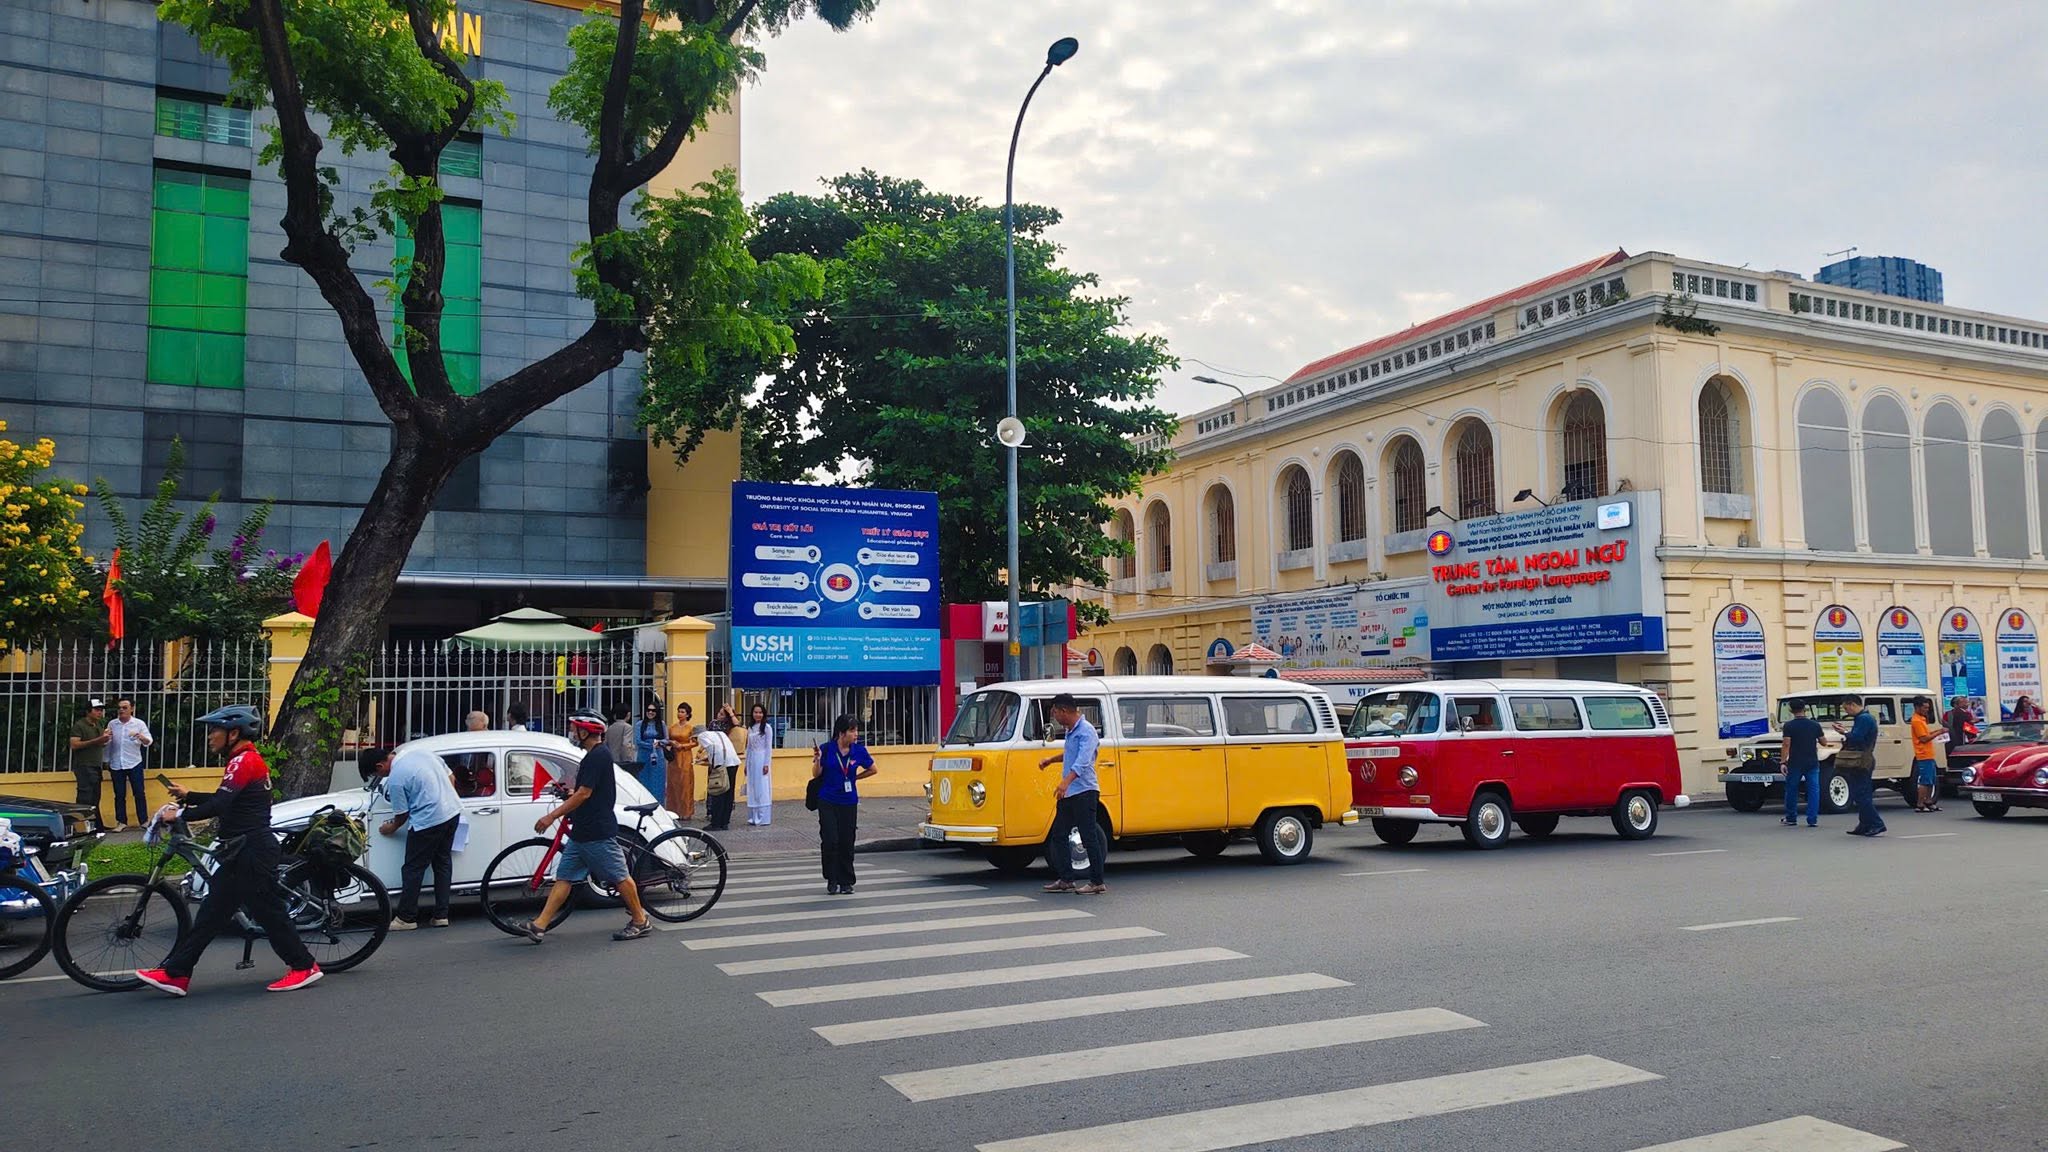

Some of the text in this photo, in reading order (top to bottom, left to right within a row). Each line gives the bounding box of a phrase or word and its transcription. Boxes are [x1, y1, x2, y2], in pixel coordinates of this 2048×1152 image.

[1489, 517, 1505, 525] QUỐC
[1567, 505, 1582, 513] MINH
[1491, 525, 1512, 533] National
[1513, 521, 1535, 530] University
[1519, 531, 1532, 539] HỌC
[1467, 545, 1491, 554] University
[1498, 541, 1514, 549] Social
[1515, 538, 1539, 548] Sciences
[1551, 532, 1584, 541] Humanities
[1432, 540, 1628, 582] TRUNG TÂM NGOẠI NGỮ
[1446, 569, 1611, 597] Center for Foreign Languages
[1384, 591, 1399, 600] CHỨC
[1482, 603, 1494, 612] MỘT
[1495, 601, 1512, 609] NGÔN
[1529, 599, 1542, 607] MỘT
[1544, 595, 1557, 605] THẾ
[1557, 595, 1571, 603] GIỚI
[741, 635, 793, 652] USSH
[741, 652, 793, 662] VNUHCM
